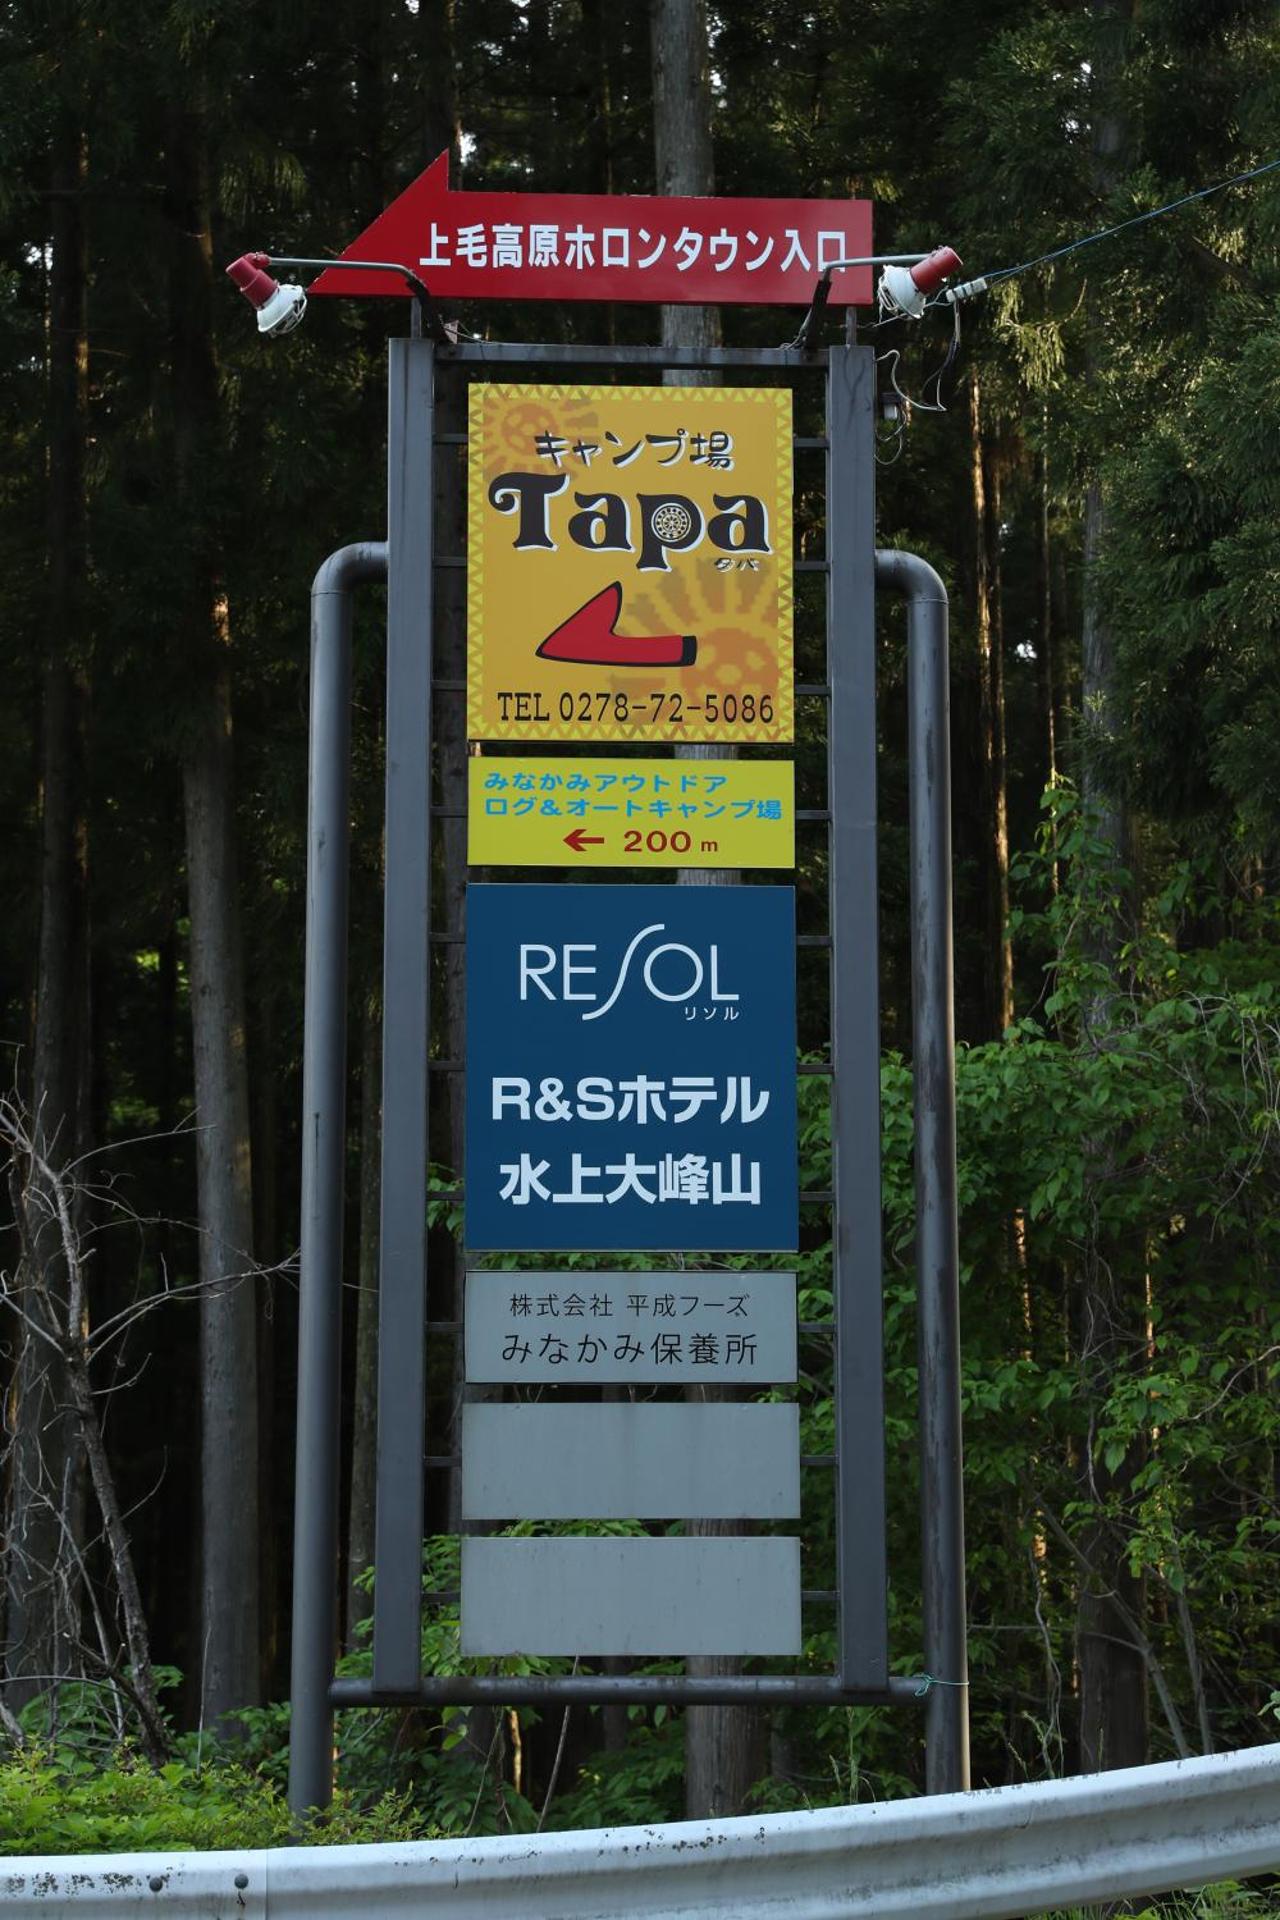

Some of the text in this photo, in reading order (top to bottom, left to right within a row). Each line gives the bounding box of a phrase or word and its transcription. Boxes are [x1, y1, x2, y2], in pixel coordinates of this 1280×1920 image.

[418, 222, 847, 273] 上毛高原ホロンタウン入口
[534, 428, 736, 471] キャンプ場
[488, 472, 774, 573] Tapa
[497, 692, 774, 723] TEL 0278-72-5086
[484, 772, 728, 793] みなかみアウトドア
[485, 797, 783, 820] ログ&オートキャンプ場
[623, 830, 692, 853] 200
[519, 923, 740, 1021] RESOL
[684, 1006, 740, 1021] リソル
[491, 1074, 770, 1125] R&Sホテル
[499, 1152, 761, 1205] 水上大峰山
[509, 1293, 750, 1318] 株式会社 平成フーズ
[502, 1331, 758, 1366] みなかみ保養所
